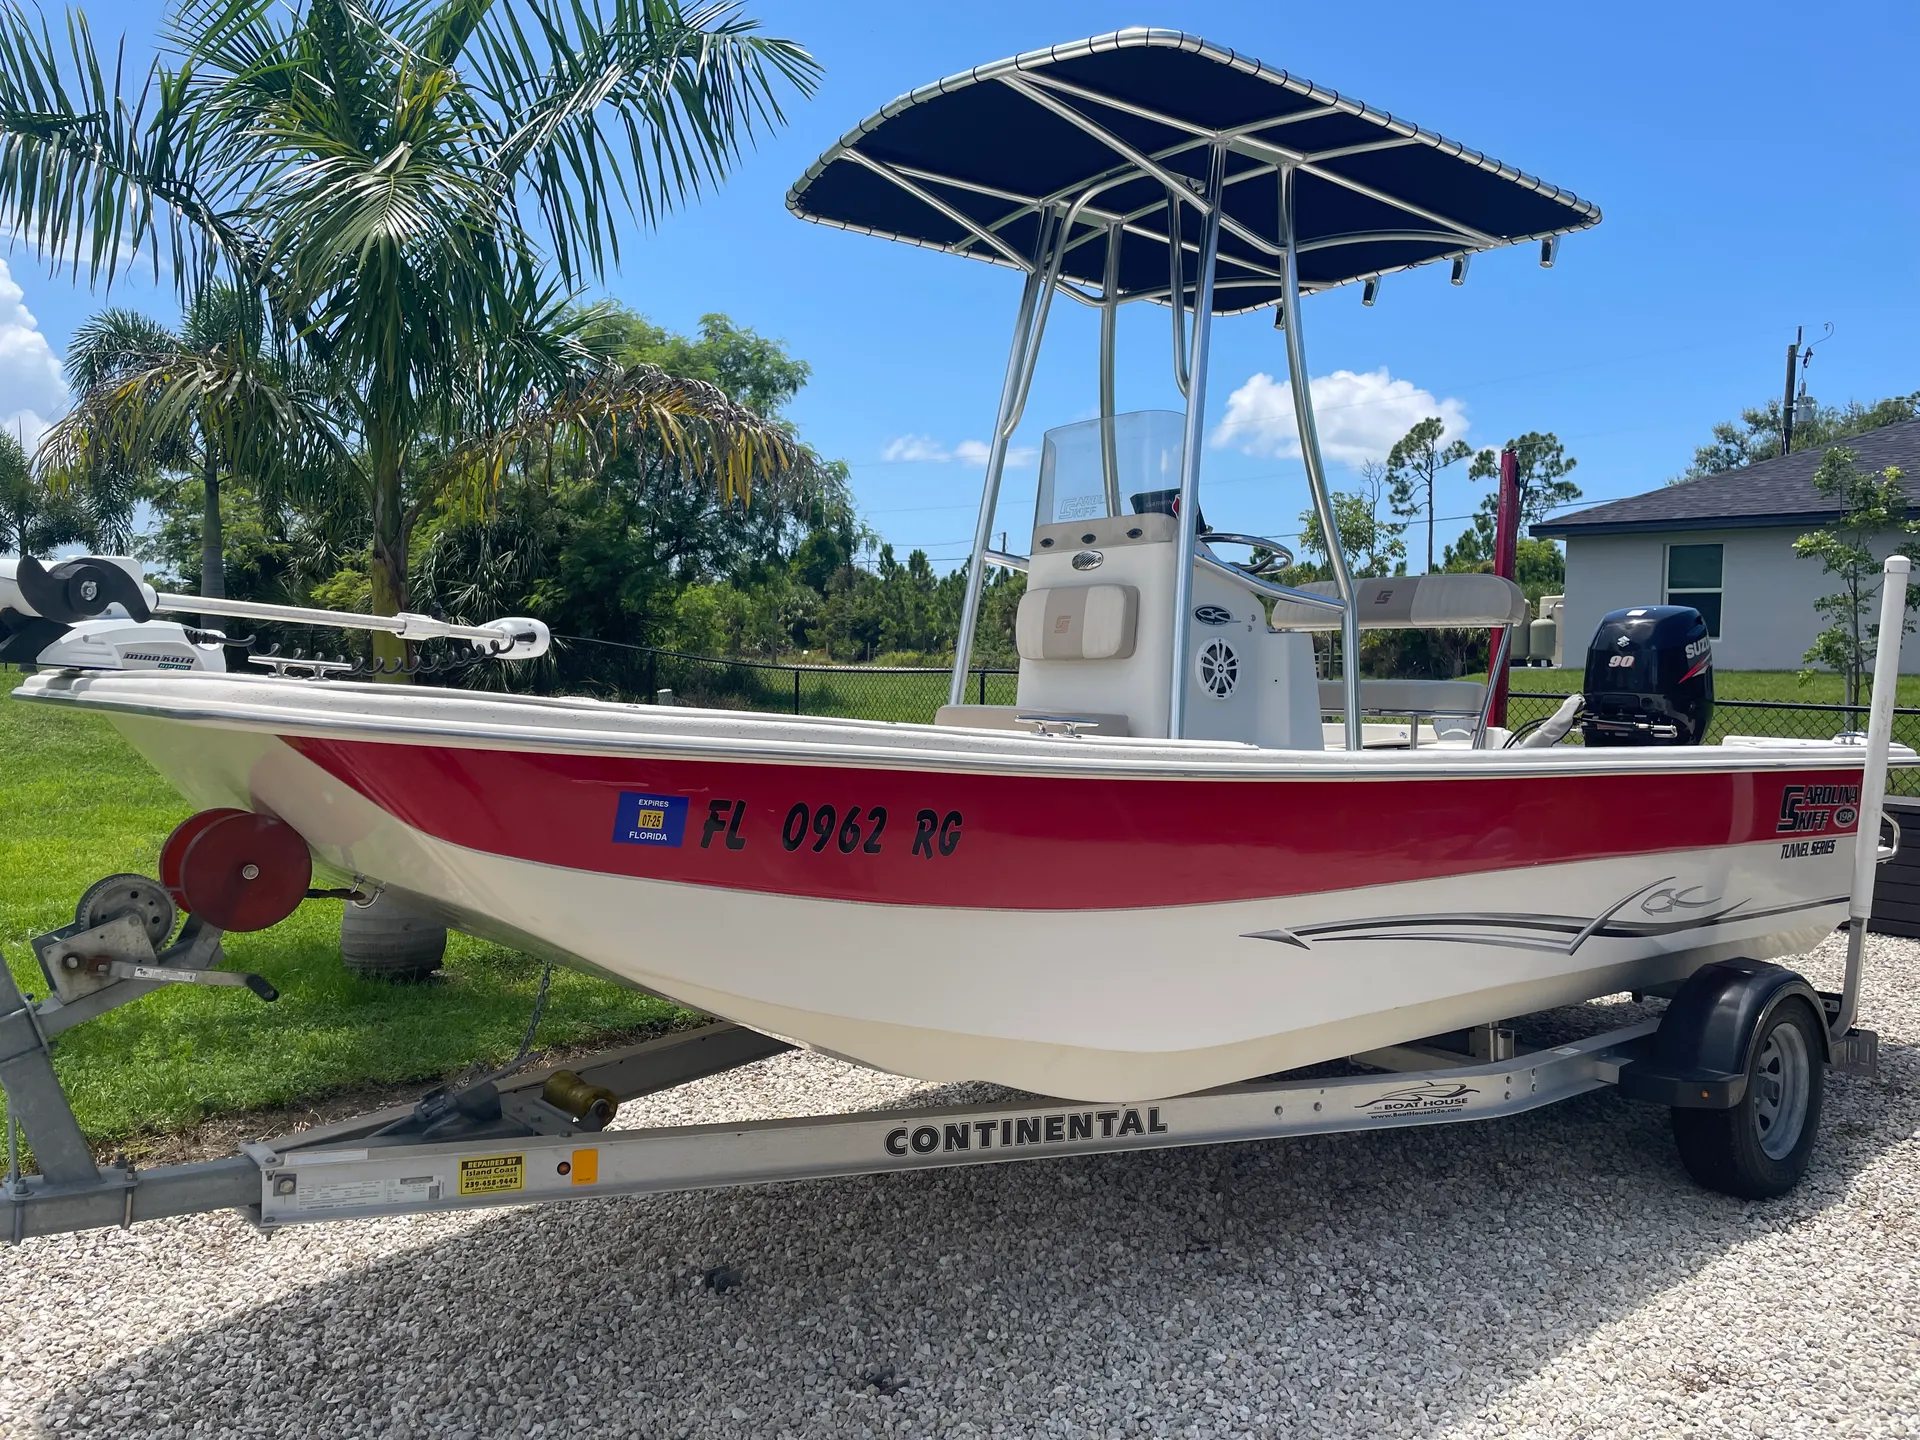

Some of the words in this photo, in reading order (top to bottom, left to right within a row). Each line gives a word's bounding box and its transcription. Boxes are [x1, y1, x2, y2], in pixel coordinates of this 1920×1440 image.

[1060, 491, 1122, 515] CAROL
[1146, 500, 1173, 508] GARMIN
[1685, 635, 1710, 659] SUZU
[1608, 655, 1635, 668] 90
[638, 798, 669, 808] EXPIRES
[1780, 785, 1859, 820] CAROLINA
[641, 814, 661, 828] 07-25
[1776, 797, 1830, 833] SKIFF
[628, 831, 668, 841] FLORIDA
[700, 799, 747, 851] FL
[782, 802, 889, 854] 0962
[911, 808, 964, 860] RG
[1780, 842, 1810, 859] TUNNEL
[1810, 840, 1837, 855] SERIES
[1384, 1102, 1420, 1110] BOAT
[1423, 1098, 1468, 1107] HOUSE
[883, 1107, 1168, 1157] CONTINENTAL
[467, 1159, 505, 1169] REPAIRED
[466, 1168, 492, 1176] Island
